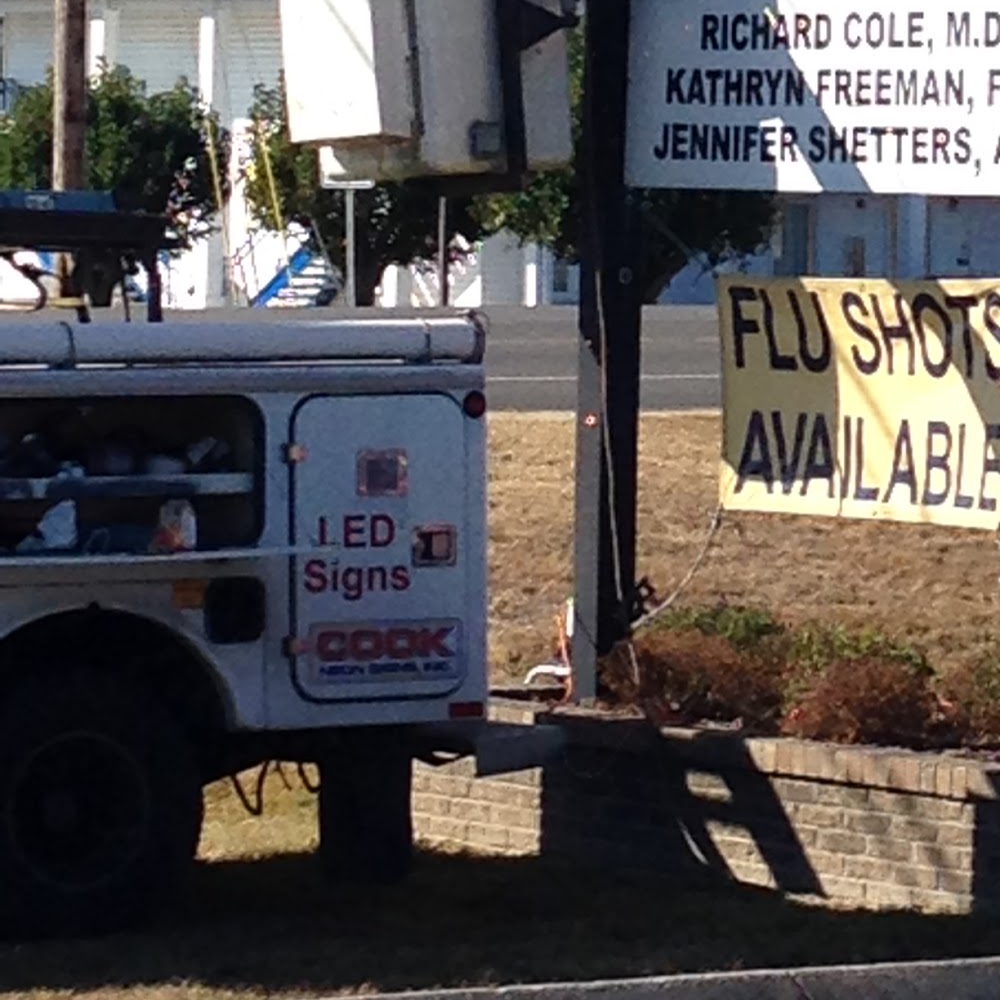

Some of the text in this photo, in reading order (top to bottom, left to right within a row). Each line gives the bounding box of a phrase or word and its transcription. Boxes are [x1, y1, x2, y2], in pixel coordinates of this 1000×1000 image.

[701, 11, 832, 51] RICHARD
[844, 11, 935, 53] COLE,
[665, 68, 805, 106] KATHRYN
[816, 68, 975, 115] FREEMAN,
[653, 122, 798, 163] JENNIFER
[808, 124, 983, 176] SHETTERS,
[728, 286, 833, 373] FLU
[317, 513, 396, 549] LED
[303, 557, 412, 601] Signs
[317, 627, 456, 662] COOK
